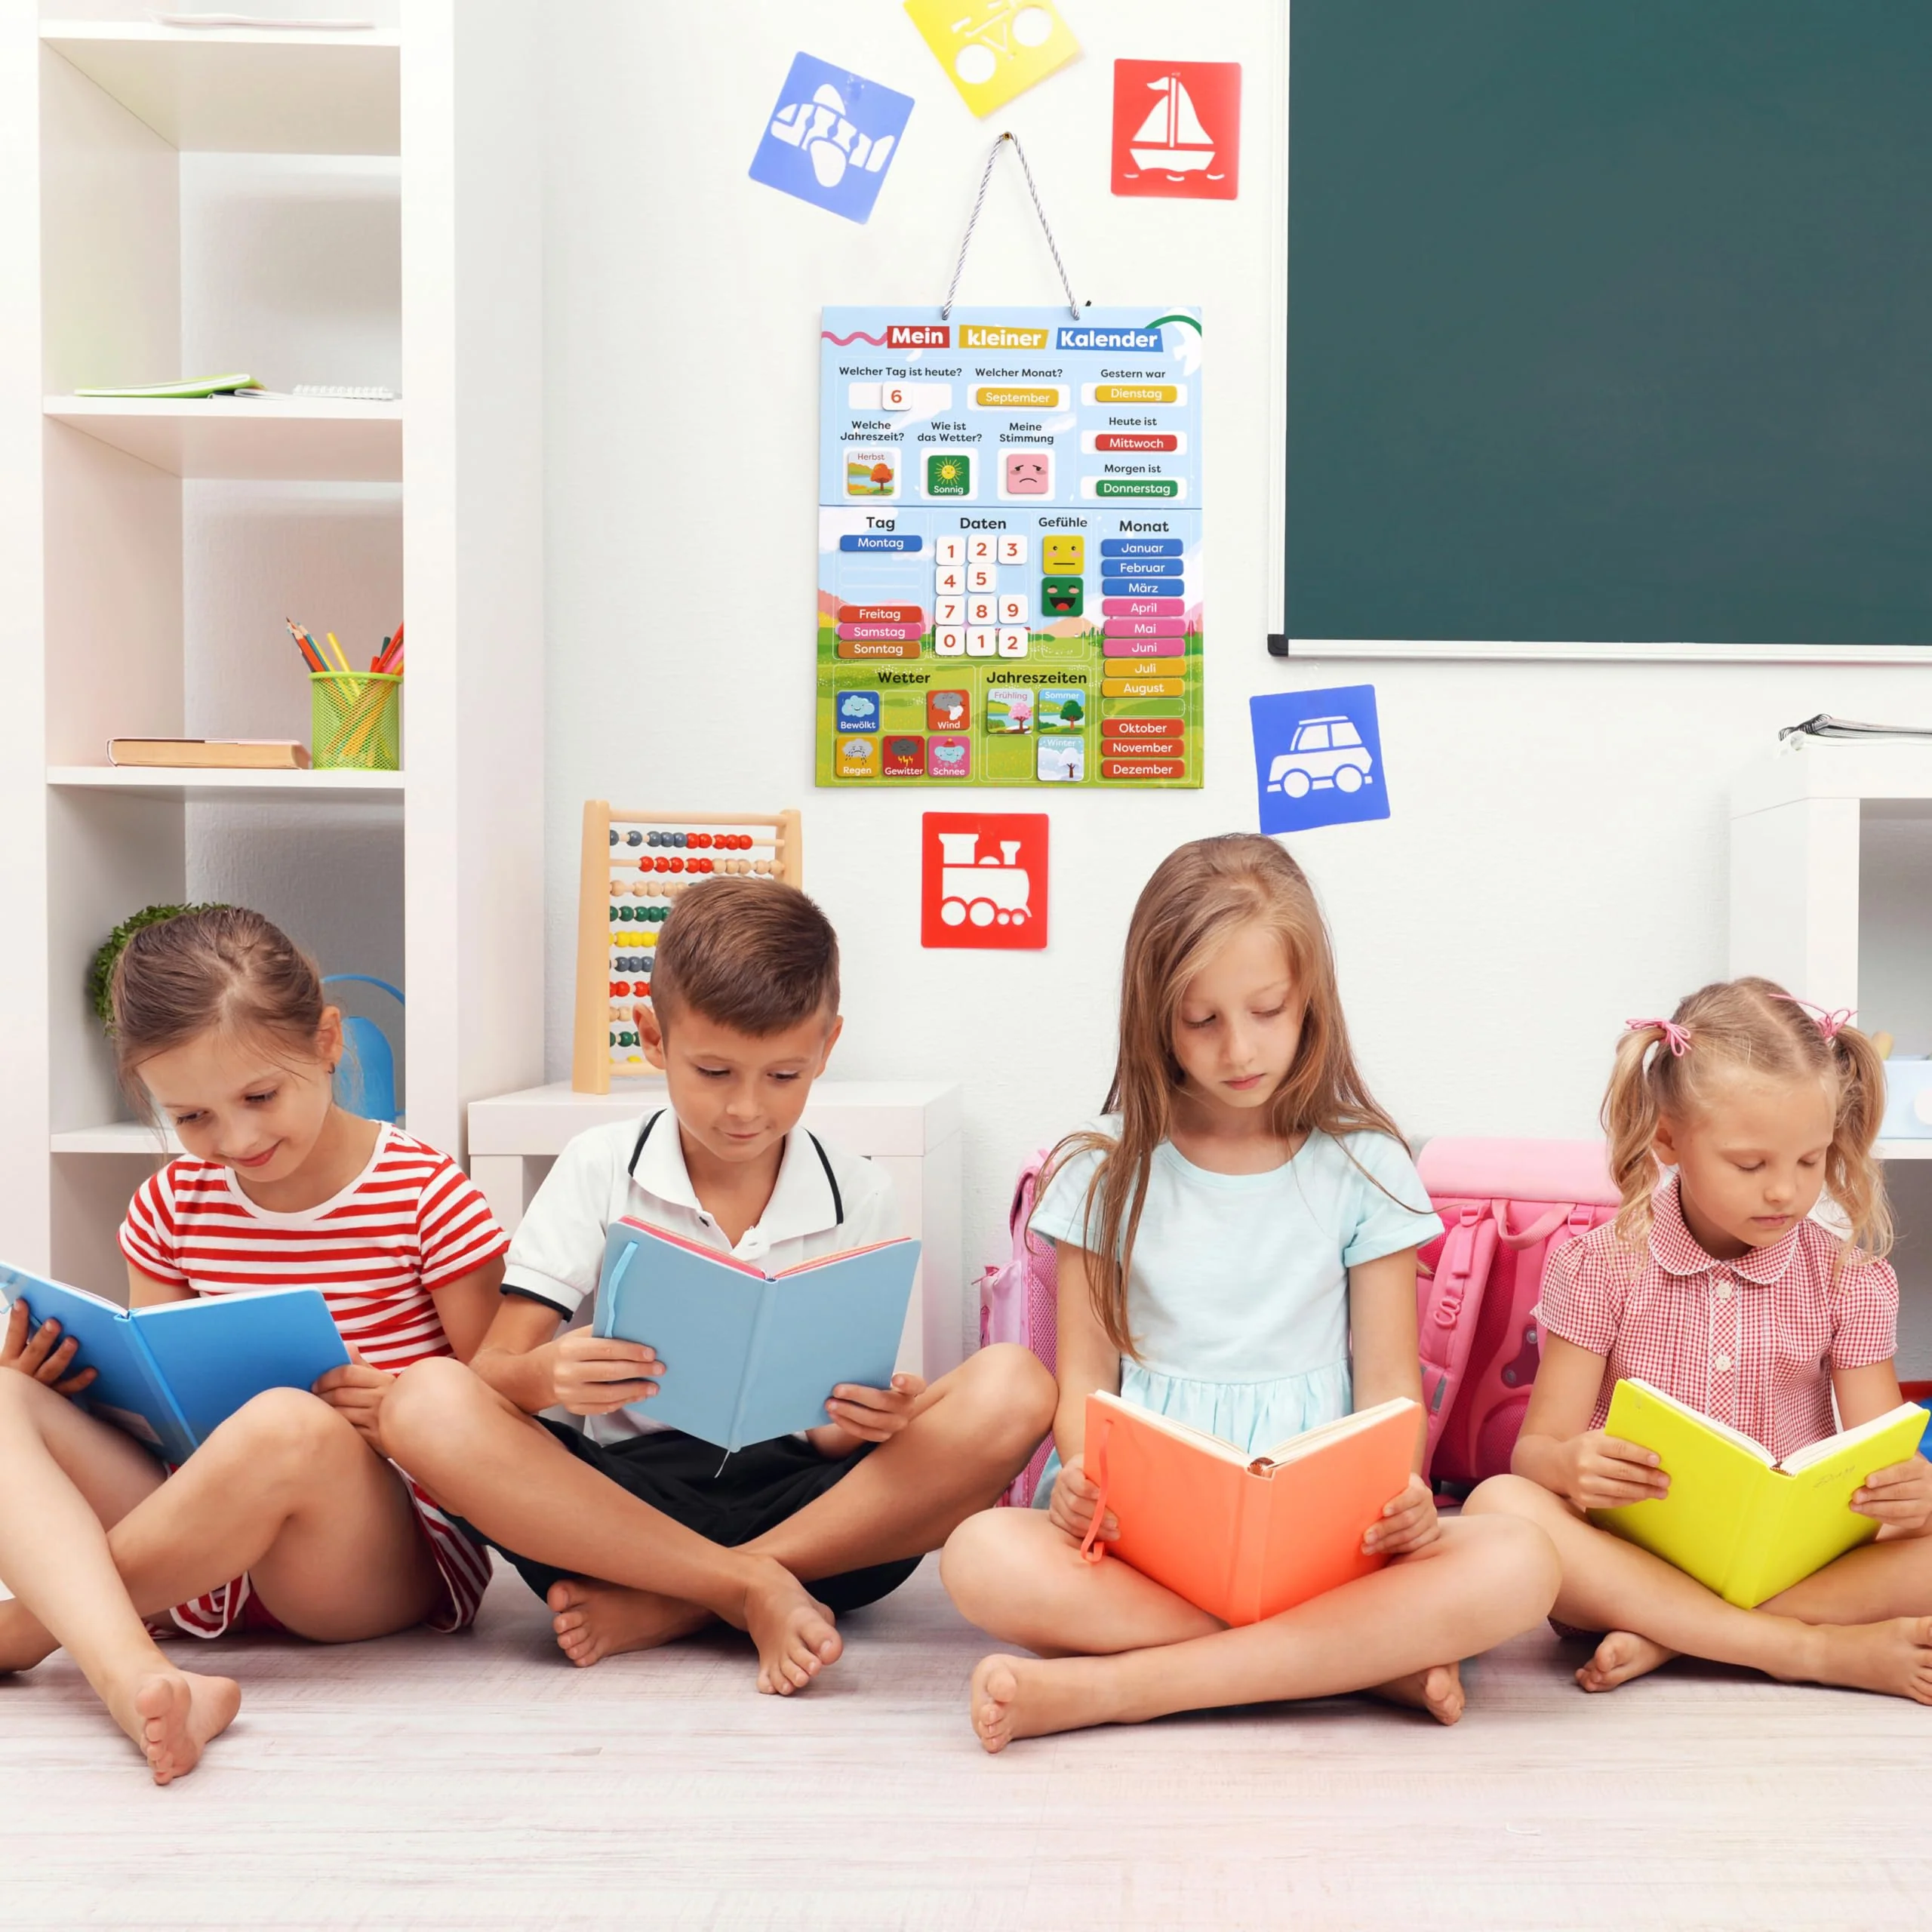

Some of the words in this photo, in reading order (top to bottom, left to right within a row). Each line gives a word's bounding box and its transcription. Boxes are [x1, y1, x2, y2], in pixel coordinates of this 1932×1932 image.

[892, 328, 943, 344] Mein
[968, 329, 1041, 346] kleiner
[1061, 331, 1157, 347] Kalender
[839, 367, 883, 376] Welcher
[886, 368, 906, 378] Tag
[909, 368, 922, 376] ist
[924, 368, 962, 377] heute?
[975, 368, 1019, 377] Welcher
[1022, 368, 1063, 378] Monat?
[1101, 369, 1142, 378] Gestern
[891, 390, 902, 403] 6
[986, 392, 1050, 406] September
[1111, 389, 1162, 401] Dienstag
[851, 420, 891, 429] Welche
[931, 422, 950, 430] Wie
[952, 422, 966, 430] ist
[1009, 423, 1041, 431] Meine
[1109, 417, 1141, 426] Heute
[1143, 417, 1157, 426] ist
[841, 432, 904, 441] Jahreszeit?
[918, 433, 937, 441] das
[939, 433, 982, 442] Wetter?
[999, 434, 1054, 445] Stimmung
[1109, 438, 1164, 448] Mittwoch
[1104, 464, 1145, 475] Morgen
[1148, 464, 1161, 473] ist
[934, 485, 963, 495] Sonnig
[1103, 484, 1171, 495] Donnerstag
[866, 517, 895, 531] Tag
[960, 518, 1006, 529] Daten
[1038, 516, 1088, 528] Gefühle
[1119, 521, 1168, 532] Monat
[858, 537, 904, 549] Montag
[1121, 543, 1163, 553] Januar
[948, 545, 954, 558] 1
[977, 543, 986, 555] 2
[1008, 543, 1017, 556] 3
[1121, 563, 1165, 574] Februar
[944, 575, 956, 588] 4
[977, 573, 986, 586] 5
[1128, 582, 1158, 593] März
[859, 608, 900, 620] Freitag
[945, 605, 955, 618] 7
[977, 605, 987, 618] 8
[1008, 604, 1018, 617] 9
[1131, 602, 1157, 615] April
[854, 626, 905, 638] Samstag
[1135, 623, 1156, 634] Mai
[944, 635, 955, 647] 0
[978, 635, 983, 648] 1
[1008, 636, 1017, 649] 2
[1131, 642, 1157, 653] Juni
[854, 644, 903, 655] Sonntag
[1135, 663, 1156, 673] Juli
[878, 672, 930, 684] Wetter
[986, 672, 1087, 684] Jahreszeiten
[1124, 683, 1164, 694] August
[995, 691, 1028, 701] Frühling
[841, 720, 876, 729] Bewölkt
[938, 721, 960, 729] Wind
[1119, 723, 1167, 734] Oktober
[1048, 738, 1075, 746] Winter
[1113, 743, 1172, 753] November
[843, 766, 872, 776] Regen
[885, 767, 923, 776] Gewitter
[933, 767, 964, 776] Schnee
[1113, 764, 1172, 774] Dezember
